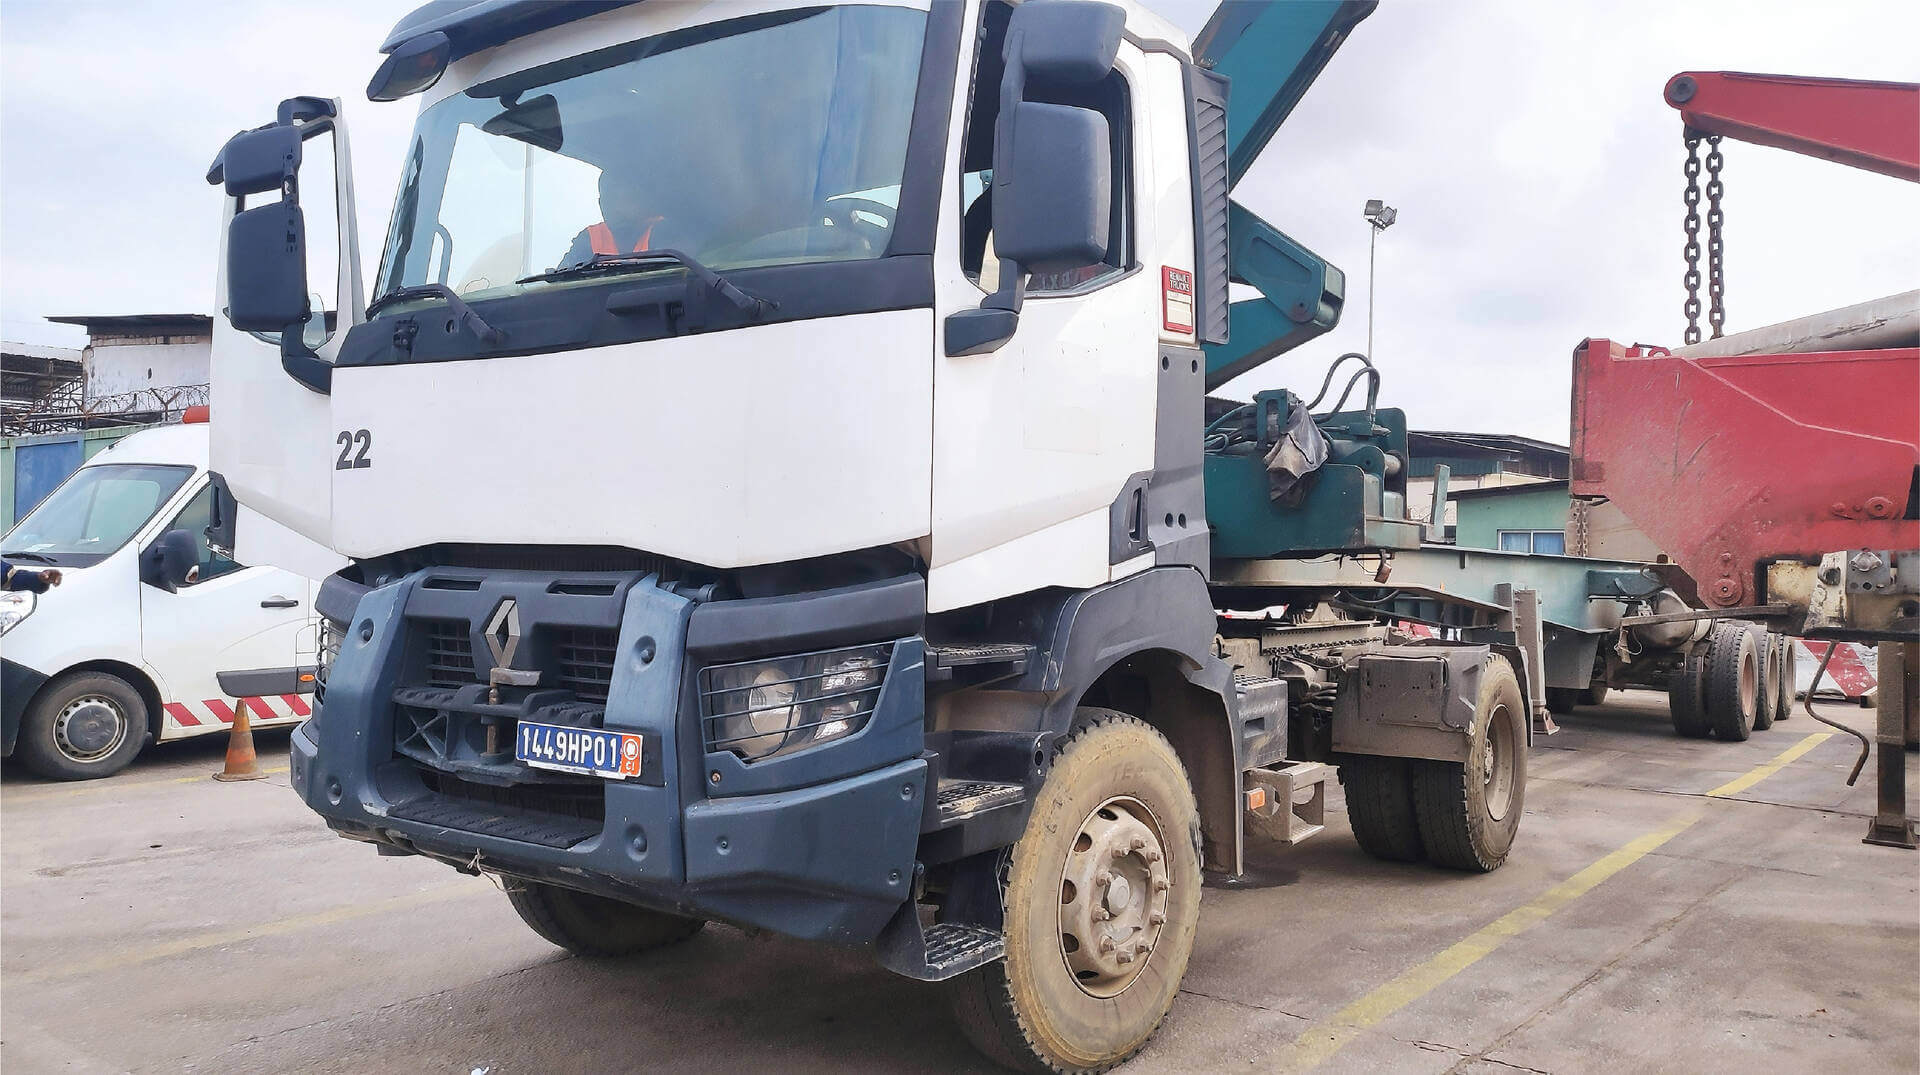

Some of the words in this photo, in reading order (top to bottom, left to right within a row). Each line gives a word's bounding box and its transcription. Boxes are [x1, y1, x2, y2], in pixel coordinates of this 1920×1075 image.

[1169, 279, 1190, 292] TRUCKS
[336, 429, 371, 470] 22
[523, 727, 617, 768] 1449HP01
